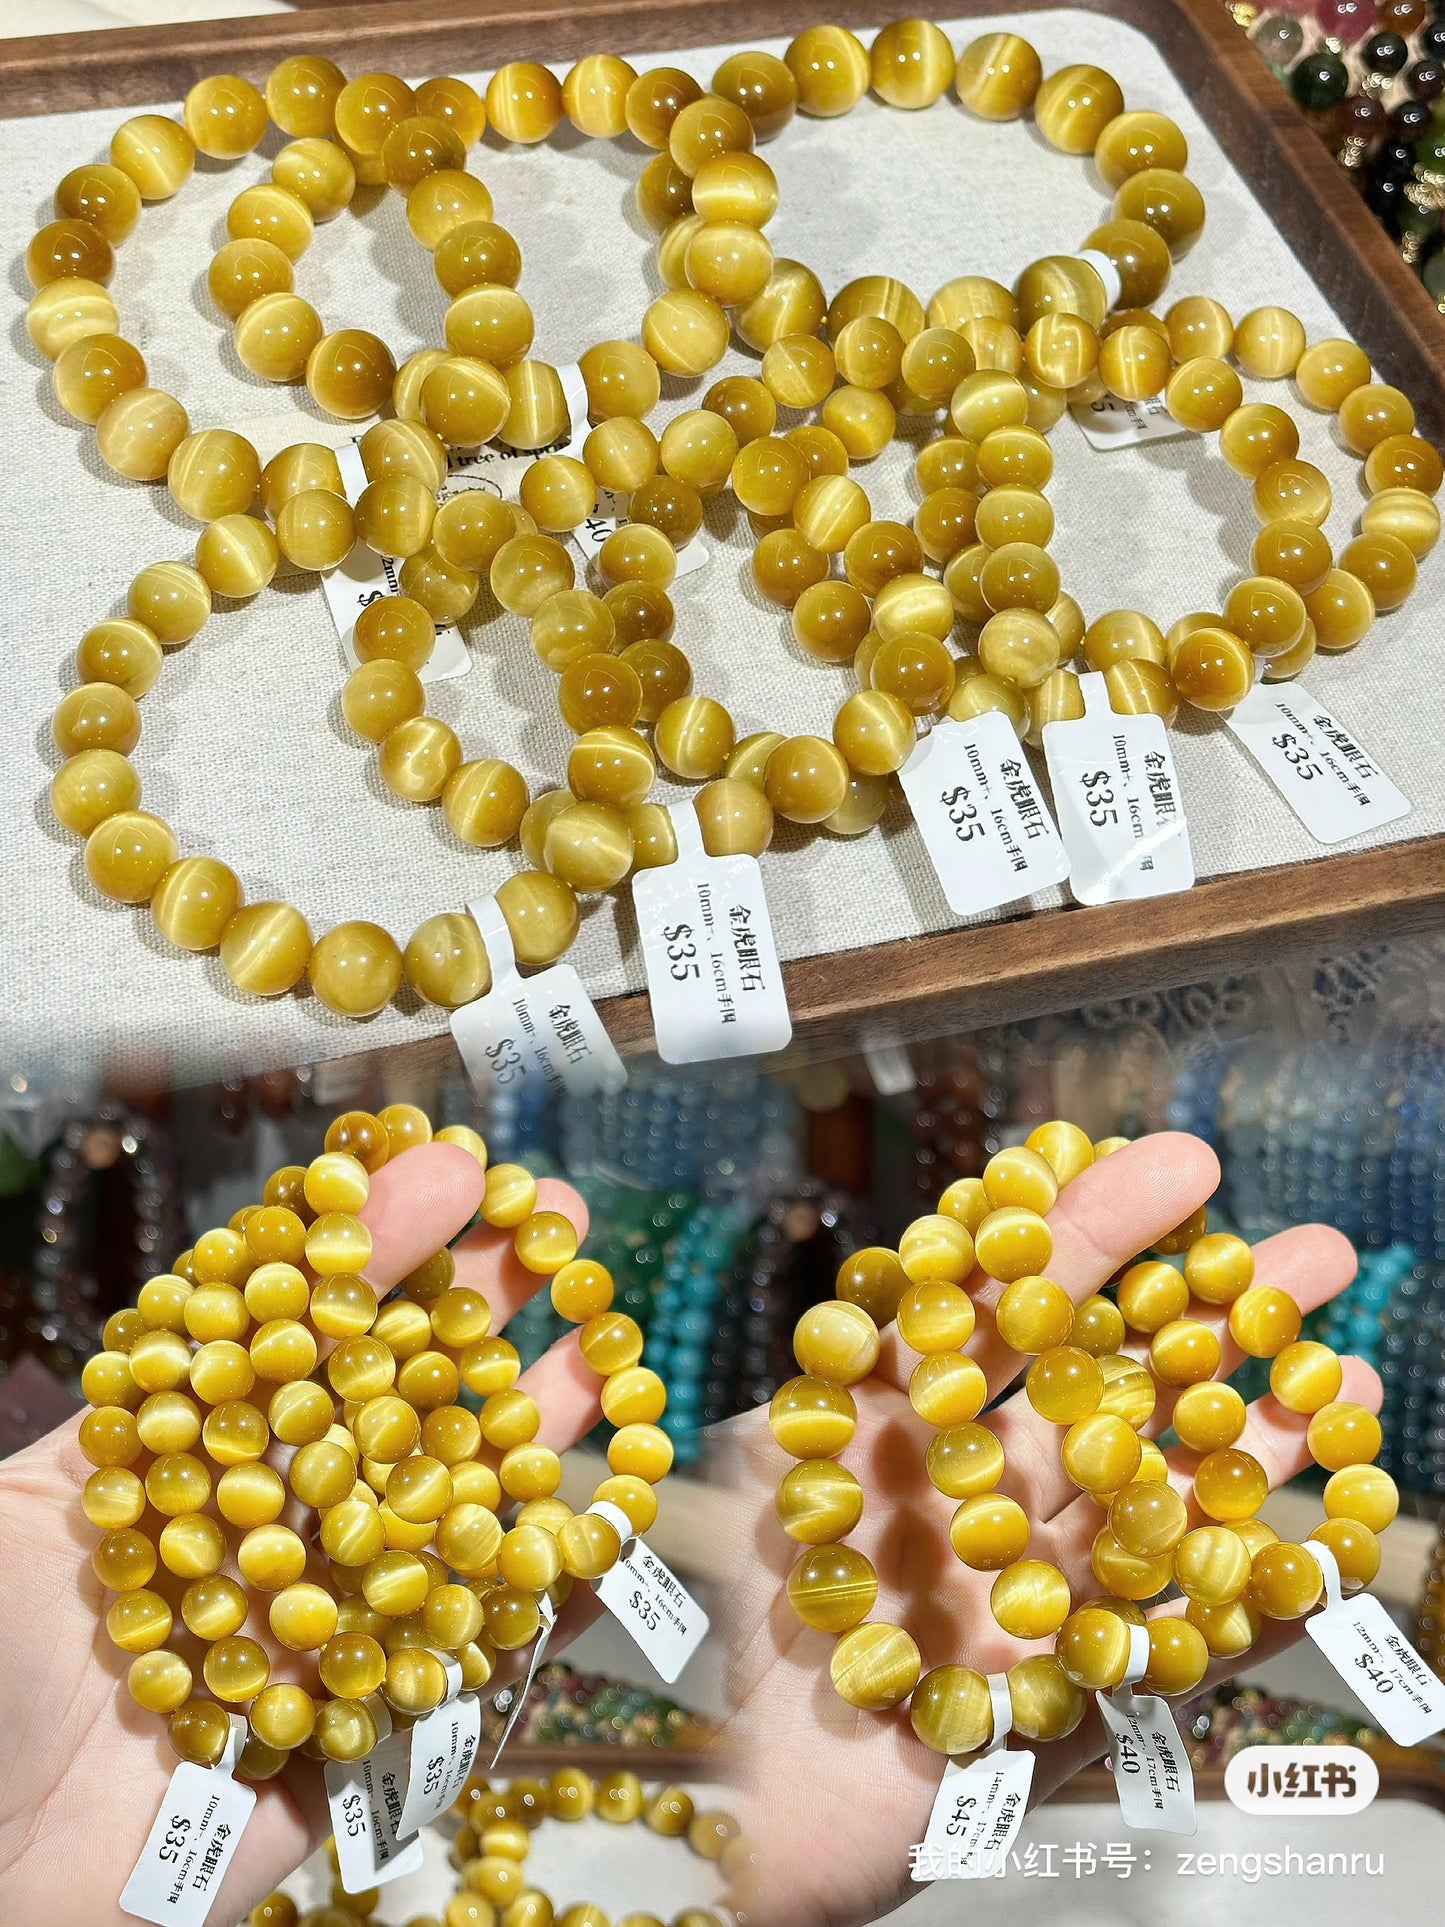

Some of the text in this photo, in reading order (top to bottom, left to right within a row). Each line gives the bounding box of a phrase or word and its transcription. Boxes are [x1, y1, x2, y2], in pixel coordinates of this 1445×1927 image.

[457, 451, 496, 468] tree
[1272, 732, 1323, 781] $35
[1313, 715, 1380, 779] 金虎眼石
[939, 785, 987, 843] $35
[999, 757, 1050, 841] 金虎眼石
[1079, 770, 1119, 828] $35
[663, 923, 700, 982] $35
[728, 904, 766, 992] 金虎眼石
[481, 1038, 527, 1085] $35
[548, 1004, 592, 1065] 金虎眼石
[642, 1554, 686, 1609] 金虎眼石
[628, 1590, 662, 1632] $35
[1354, 1653, 1394, 1694] $40
[1383, 1634, 1433, 1687] 金虎眼石
[423, 1755, 445, 1796] $35
[451, 1734, 477, 1790] 金虎眼石
[1115, 1732, 1141, 1774] $40
[1151, 1731, 1181, 1792] 金虎眼石
[158, 1813, 192, 1865] $35
[342, 1794, 367, 1838] $35
[945, 1795, 977, 1837] $45
[983, 1792, 1022, 1851] 金虎眼石
[192, 1823, 231, 1890] 金虎眼石
